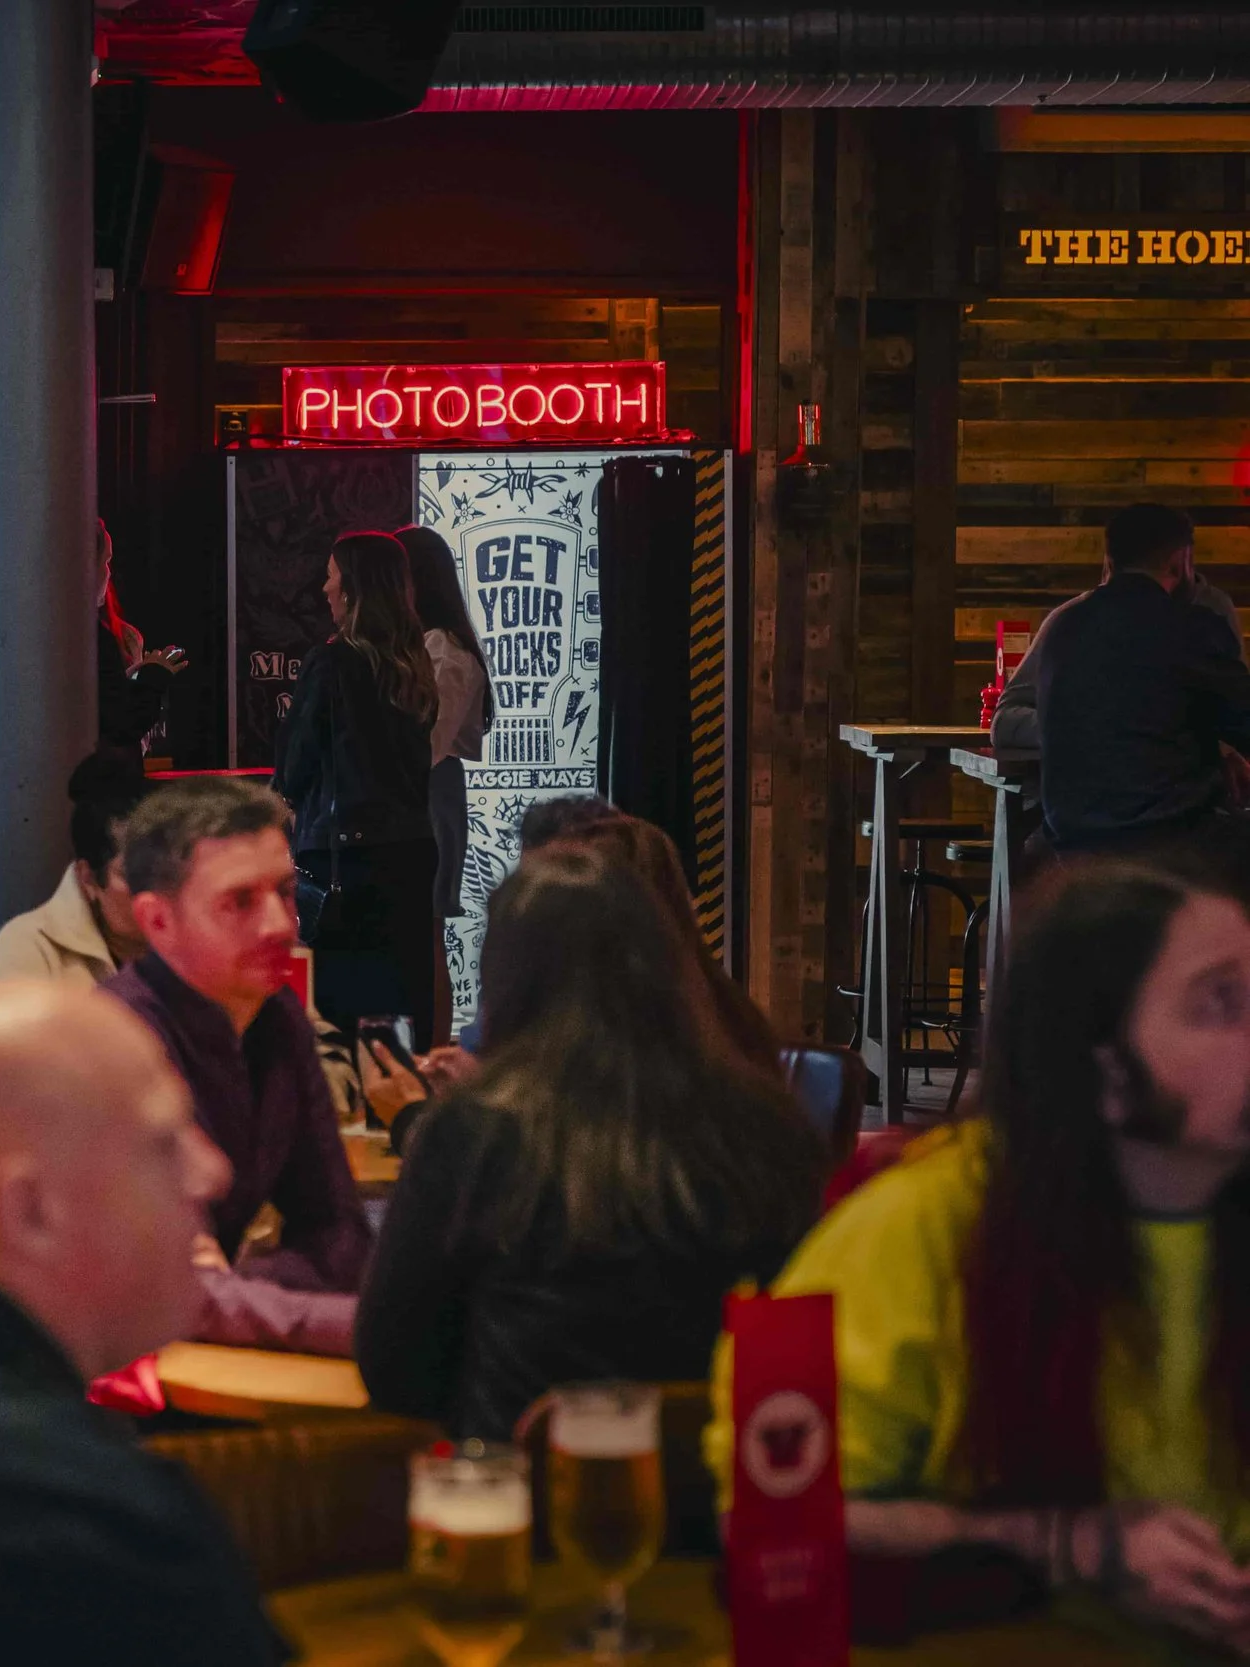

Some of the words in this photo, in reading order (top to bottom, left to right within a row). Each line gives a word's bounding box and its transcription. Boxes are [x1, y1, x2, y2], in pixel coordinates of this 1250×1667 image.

[1019, 229, 1129, 264] THE
[1136, 229, 1250, 264] HOE
[301, 383, 647, 430] PHOTOBOOTH
[475, 534, 567, 585] GET
[477, 585, 563, 632] YOUR
[482, 631, 562, 678] ROCKS
[494, 680, 550, 709] OFF
[466, 770, 531, 788] AGGIE
[538, 769, 593, 788] MAYS
